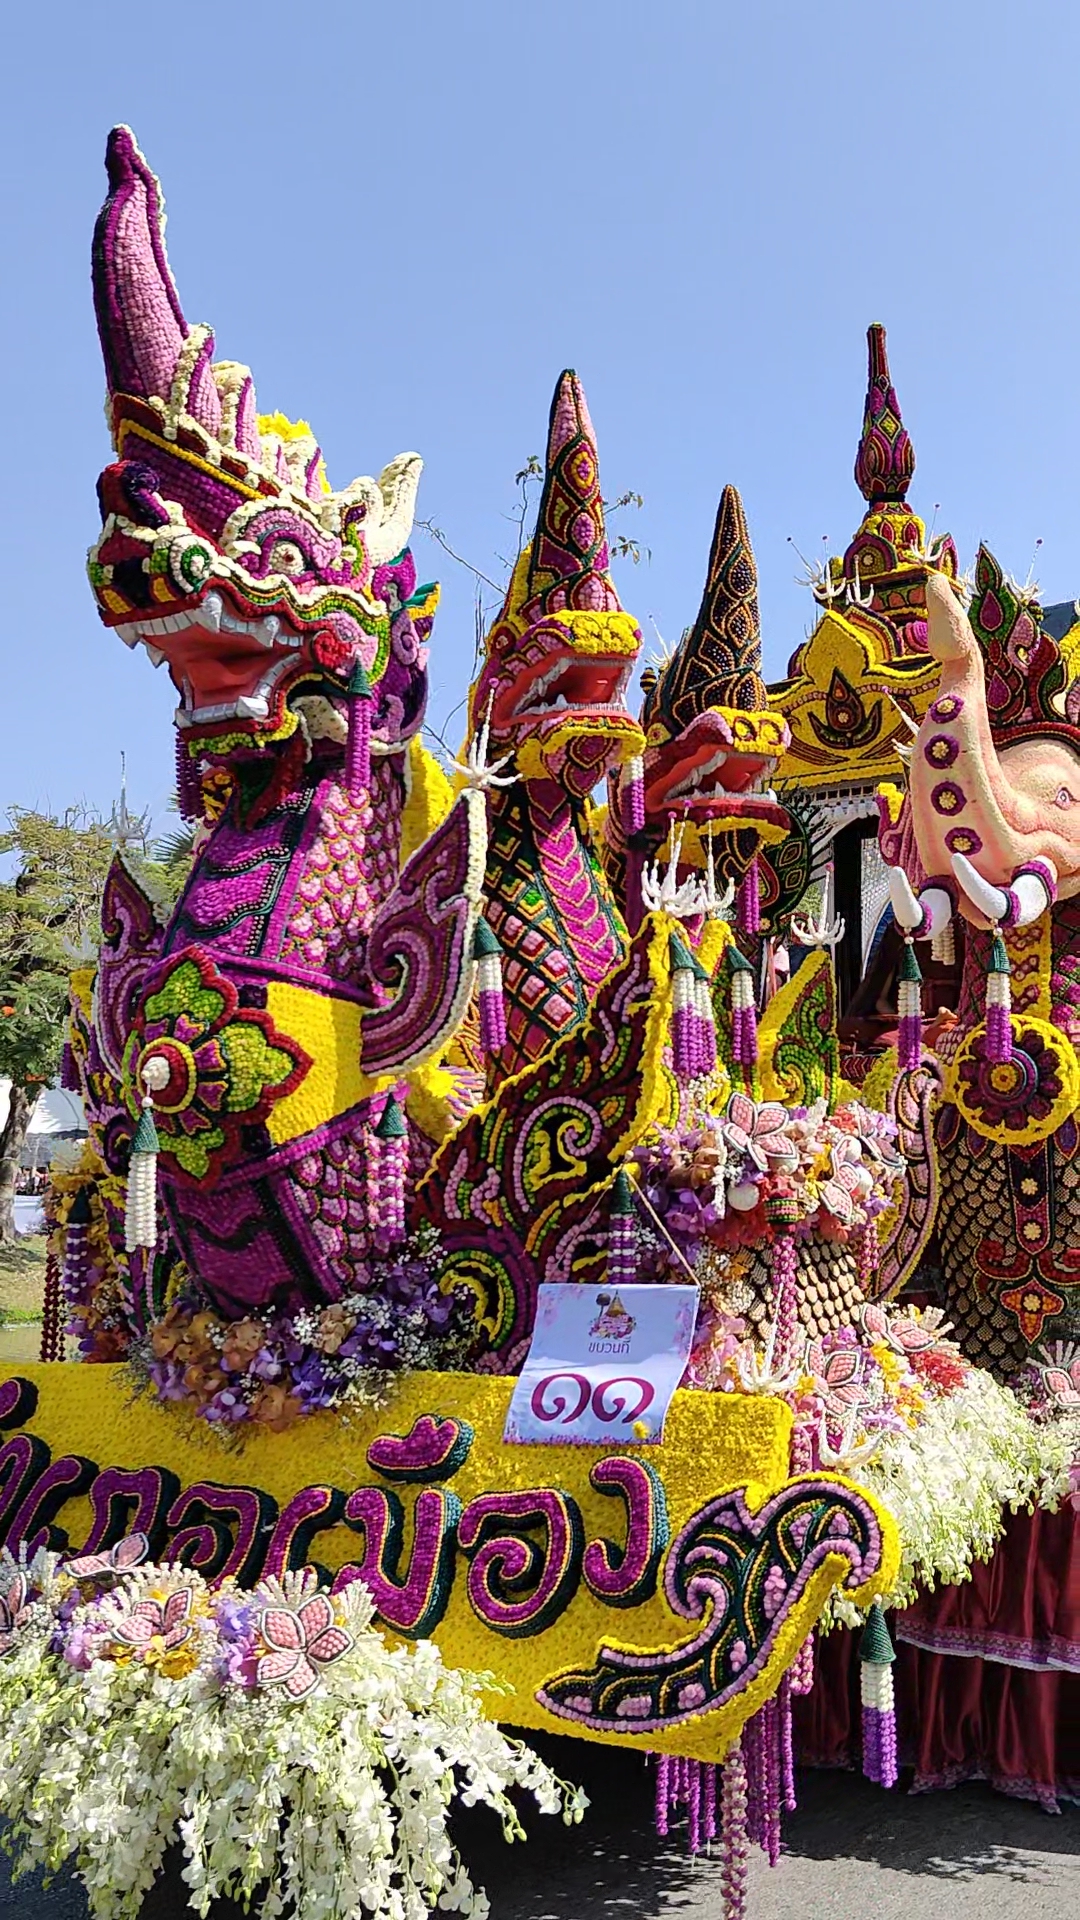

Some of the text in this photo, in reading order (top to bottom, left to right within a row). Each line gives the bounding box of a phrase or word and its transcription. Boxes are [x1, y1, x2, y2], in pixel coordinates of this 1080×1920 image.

[588, 1336, 632, 1354] ขบวนที่
[531, 1373, 655, 1424] ๑๑
